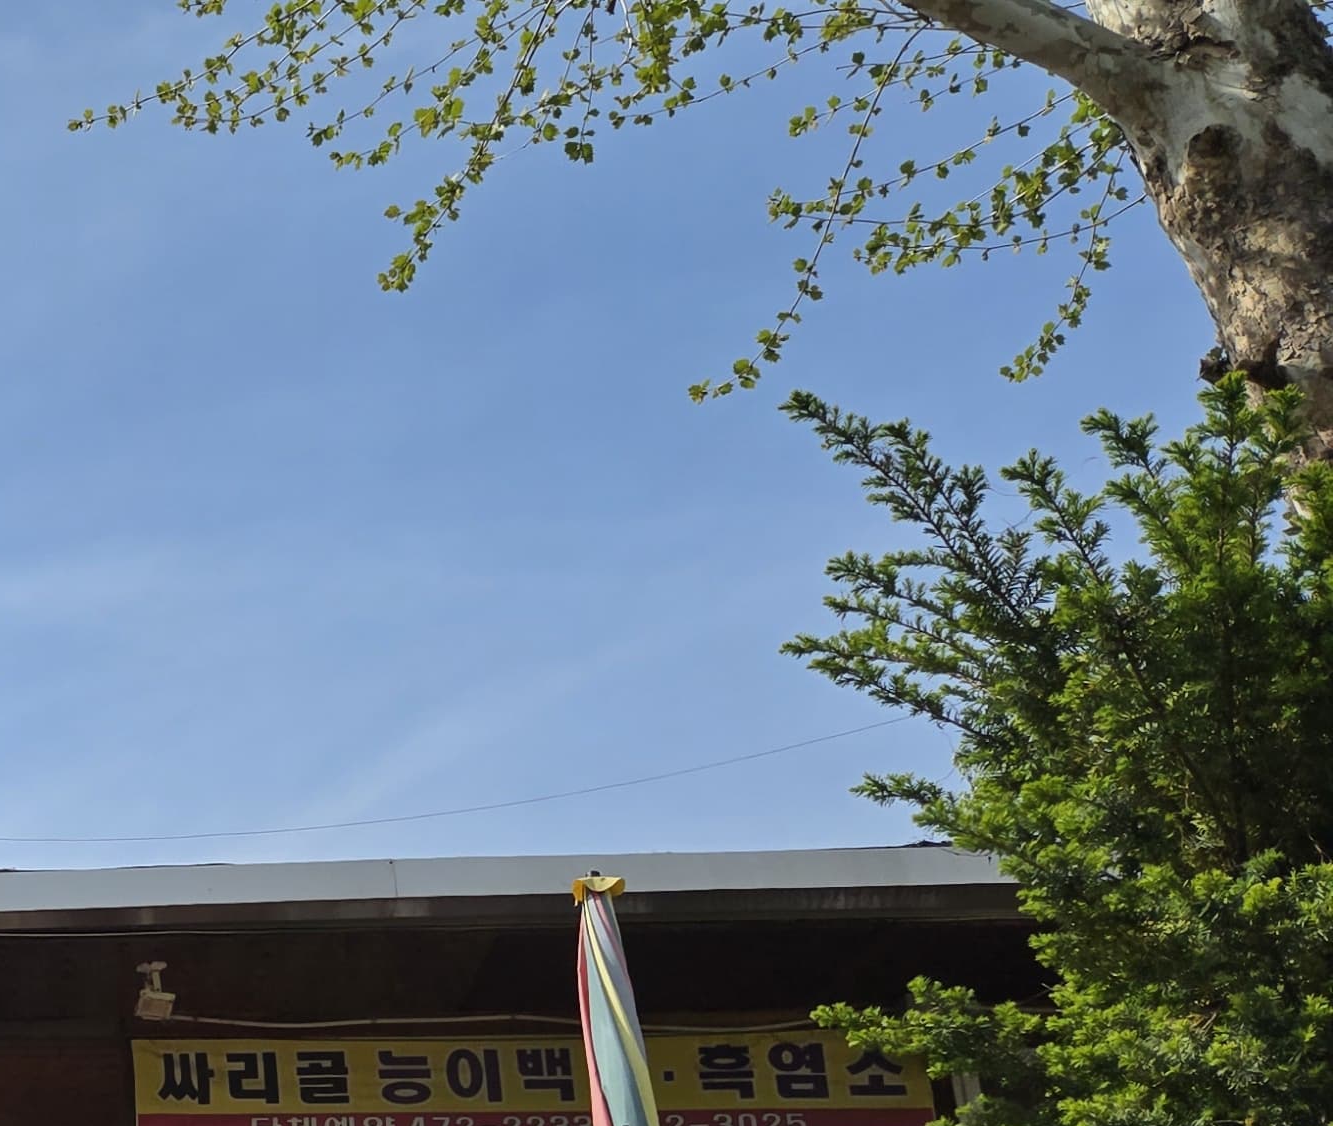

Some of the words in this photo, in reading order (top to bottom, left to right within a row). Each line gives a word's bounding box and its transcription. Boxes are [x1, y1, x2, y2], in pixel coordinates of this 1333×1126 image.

[158, 1050, 351, 1105] 싸리골
[377, 1047, 576, 1105] 능이백
[698, 1042, 909, 1100] 흑염소
